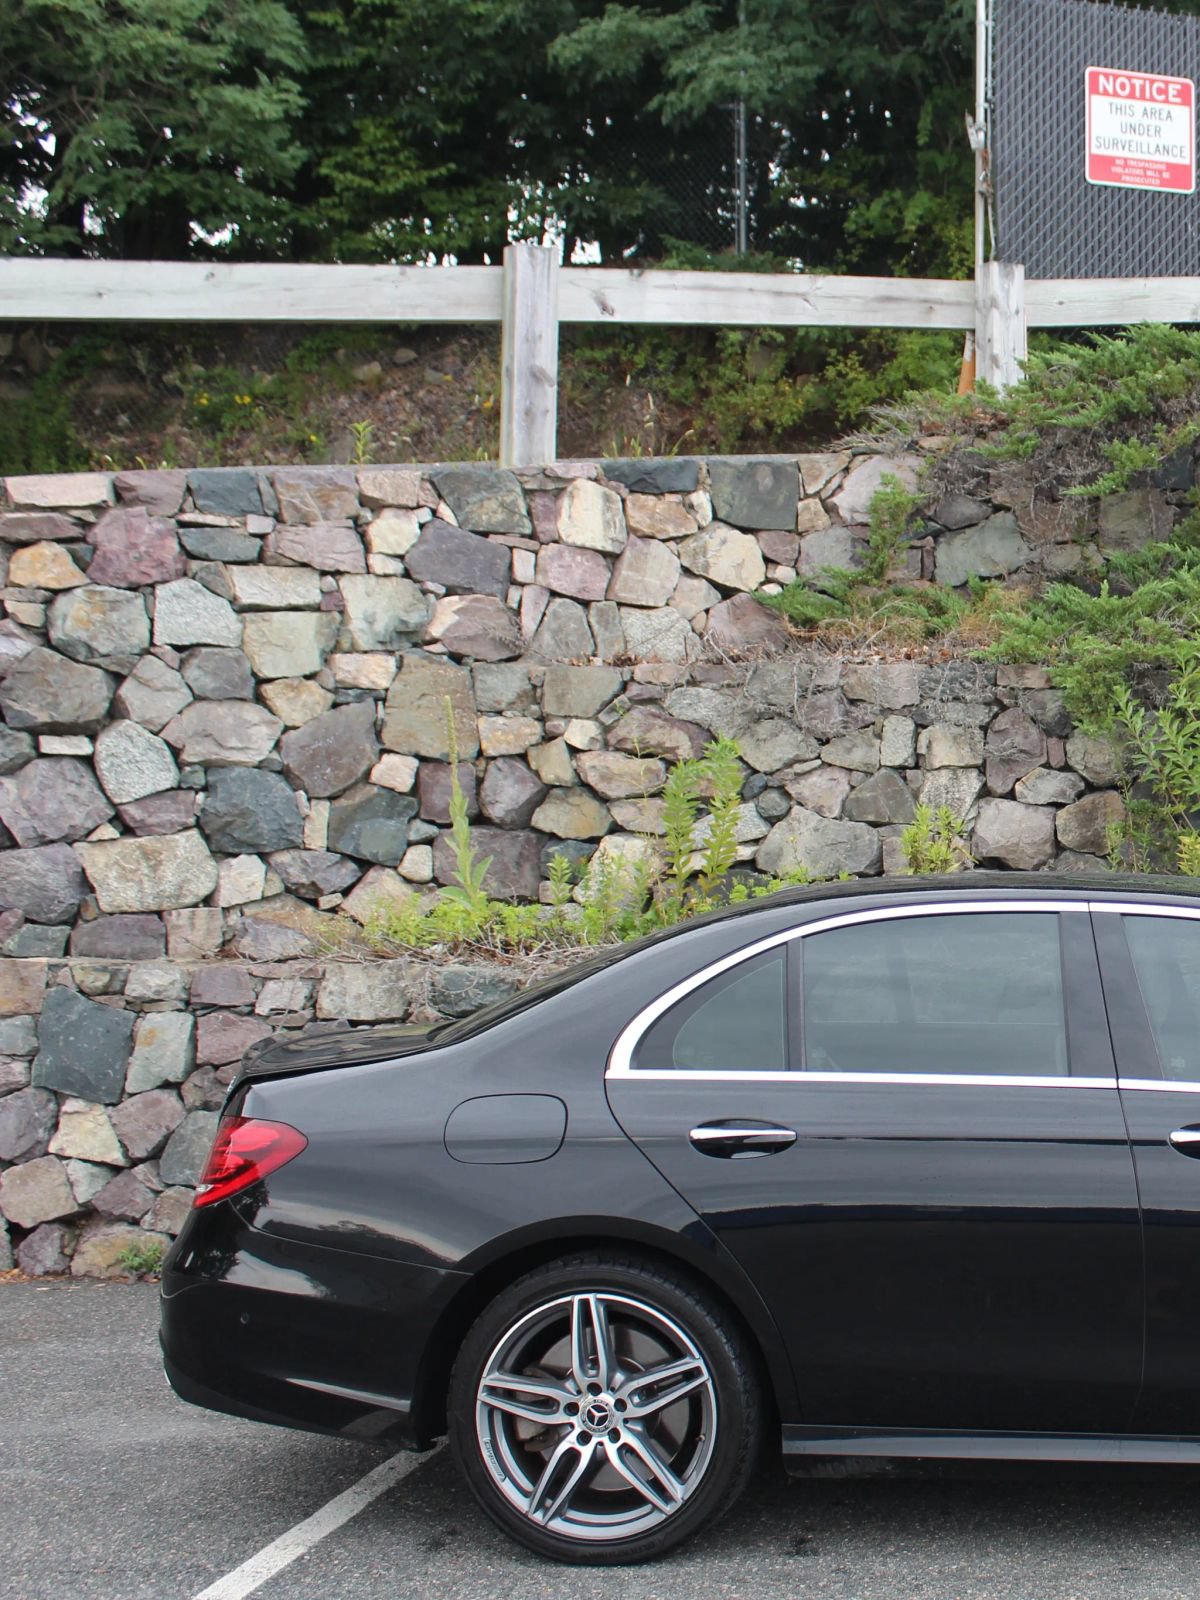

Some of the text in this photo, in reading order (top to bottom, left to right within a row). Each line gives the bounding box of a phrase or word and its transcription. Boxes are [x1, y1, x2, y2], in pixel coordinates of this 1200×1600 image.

[1099, 75, 1182, 103] NOTICE
[1108, 102, 1173, 122] THIS AREA
[1120, 121, 1162, 138] UNDER
[1095, 136, 1186, 159] SURVEILLANCE
[1115, 158, 1166, 169] NO TRESPASSING
[1111, 166, 1147, 176] VIOLATORS
[1162, 171, 1170, 179] BE
[1121, 175, 1160, 185] PROSECUTED
